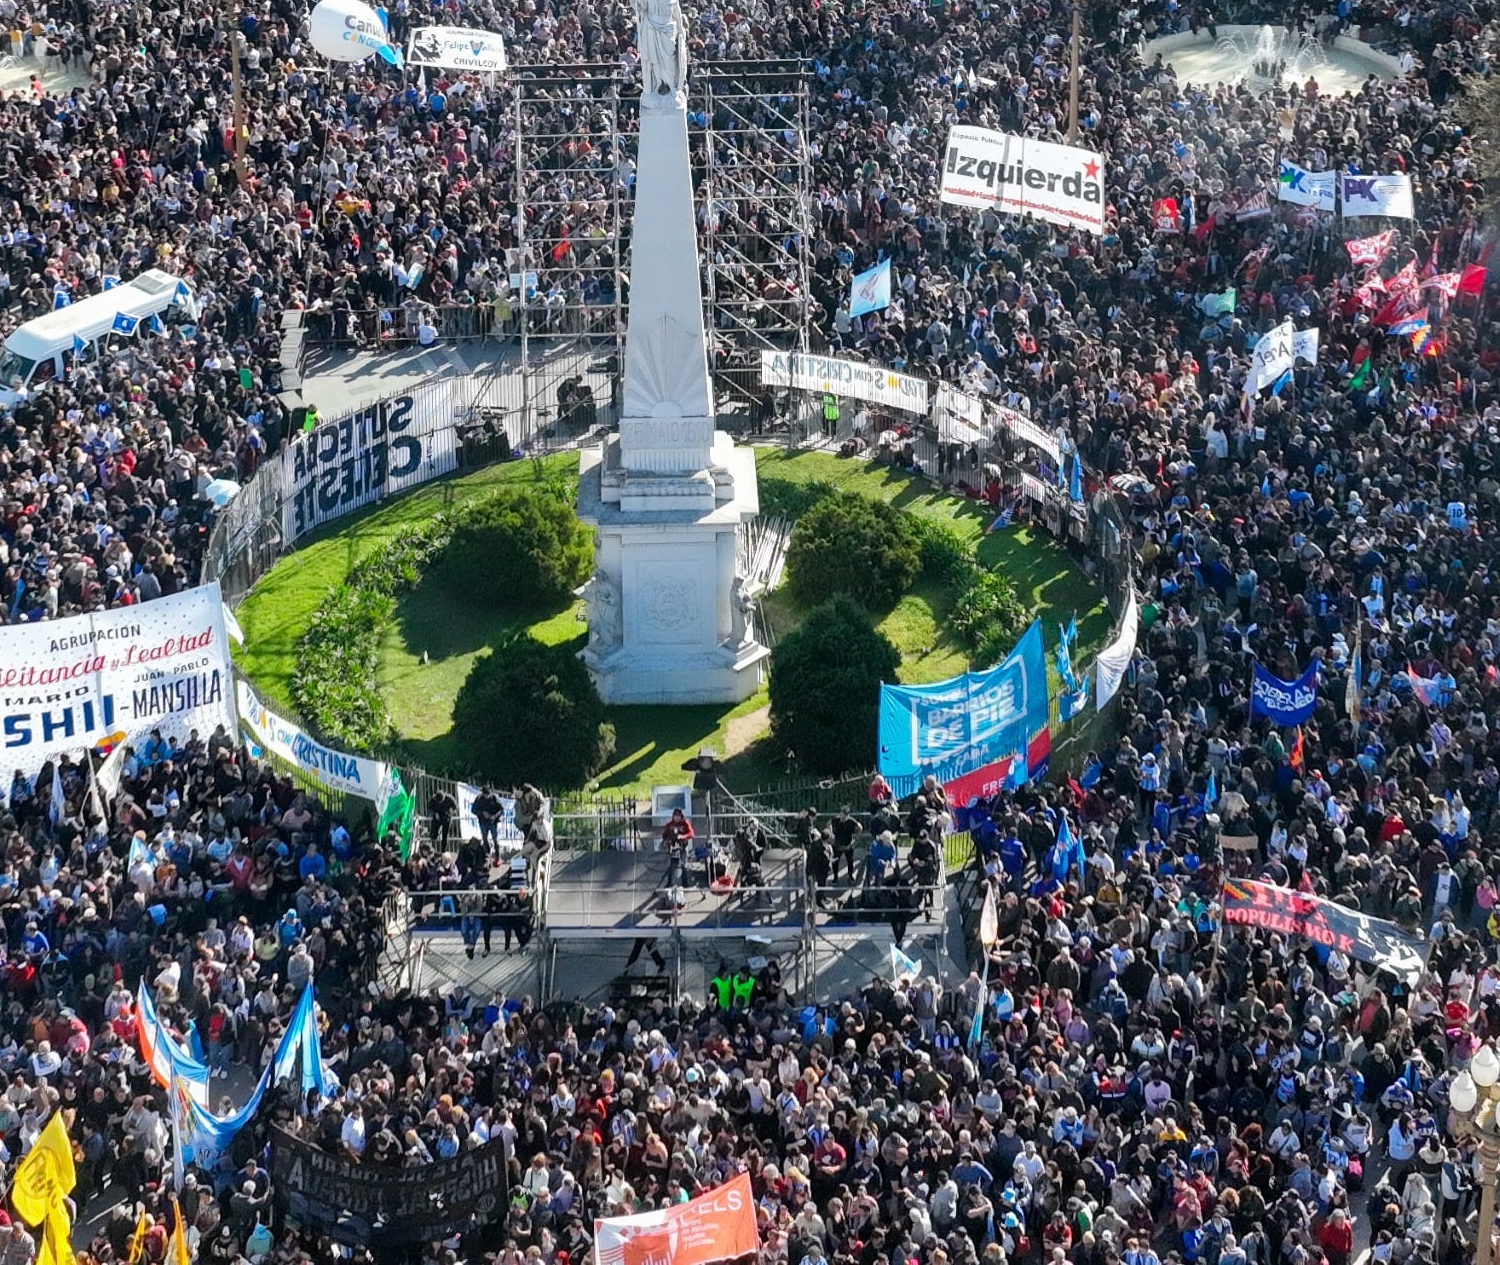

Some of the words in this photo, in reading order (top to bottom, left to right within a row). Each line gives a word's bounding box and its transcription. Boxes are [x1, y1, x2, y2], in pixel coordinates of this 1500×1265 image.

[443, 40, 469, 52] Felipe
[946, 147, 1100, 205] Izquierda
[1344, 178, 1378, 203] PK
[1452, 508, 1462, 519] 10
[121, 626, 213, 667] Lealtad
[133, 671, 165, 684] JUAN
[173, 657, 209, 675] PABLO
[4, 686, 89, 707] MARIO
[928, 678, 1015, 727] BARRIOS
[927, 718, 964, 749] DE
[971, 696, 1016, 731] PIE
[292, 732, 361, 784] CRISTINA
[1225, 908, 1336, 945] POPULISMO
[1338, 934, 1354, 953] K
